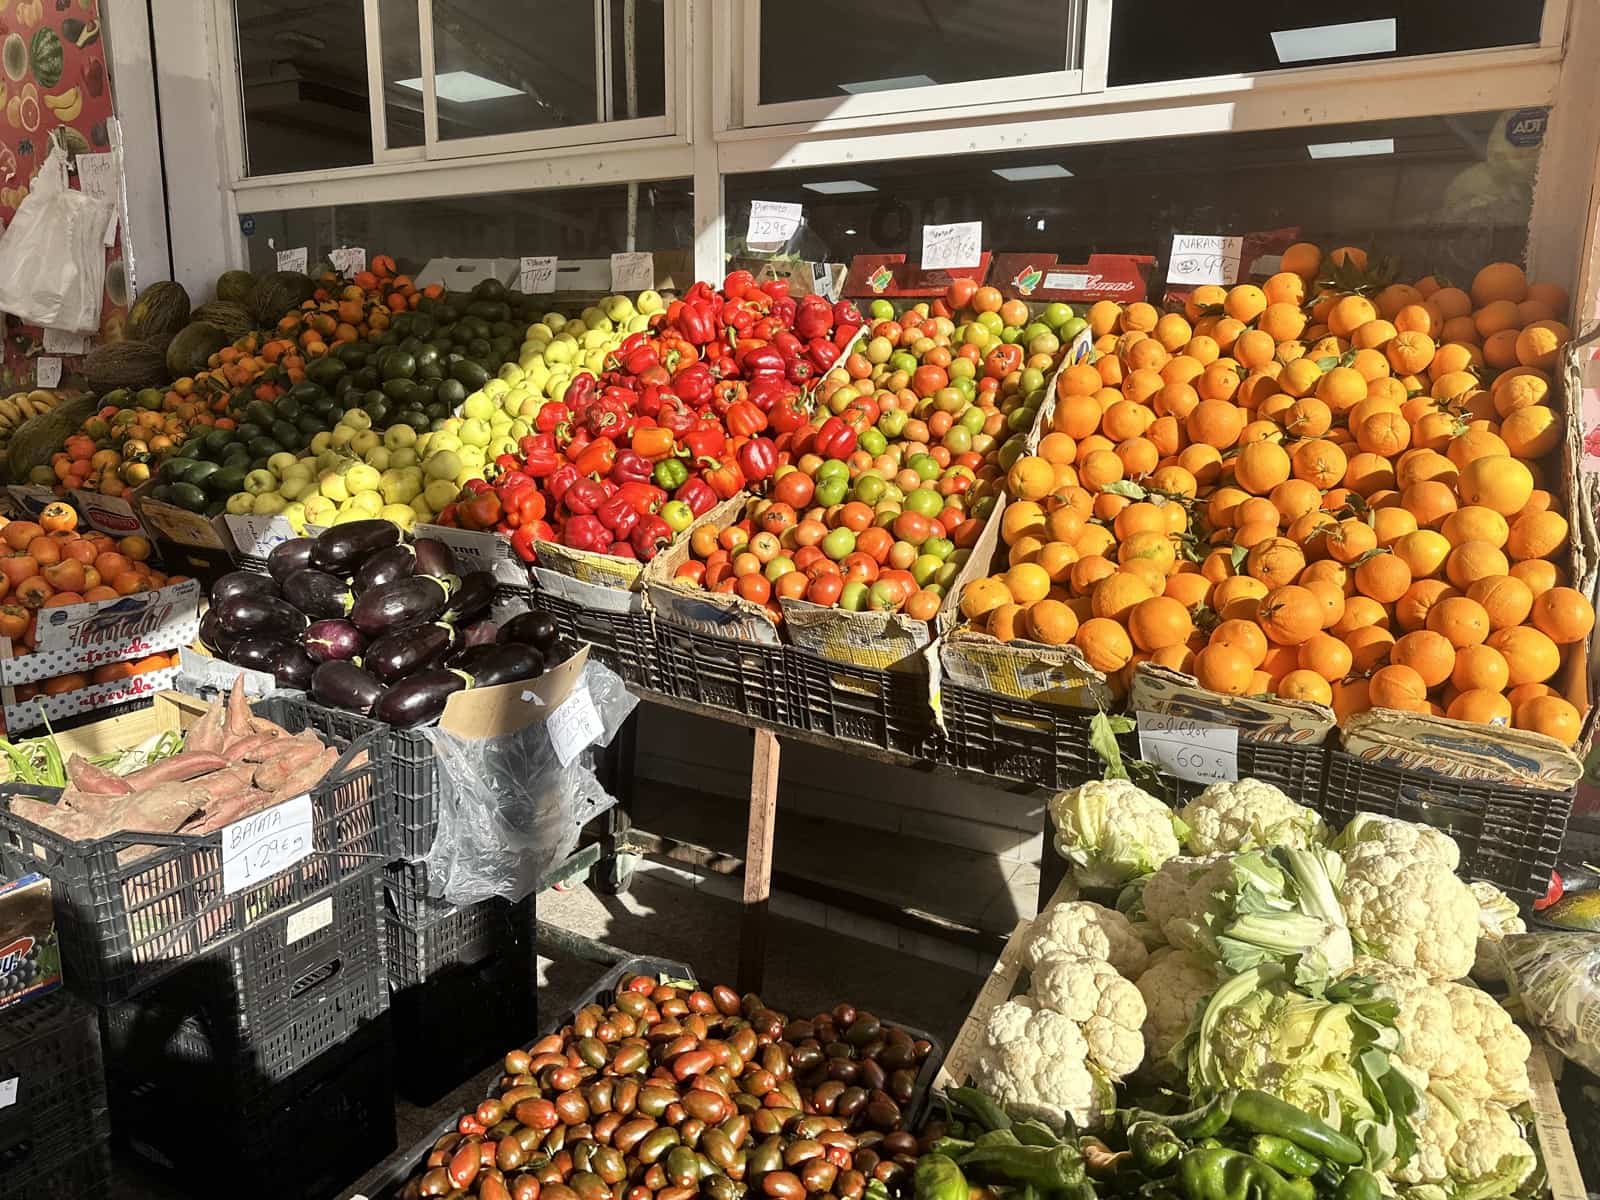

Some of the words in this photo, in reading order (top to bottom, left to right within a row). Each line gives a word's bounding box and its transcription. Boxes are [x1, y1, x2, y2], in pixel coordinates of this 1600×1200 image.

[1511, 118, 1545, 134] ADT
[1178, 238, 1234, 250] NARANJA
[77, 637, 153, 664] atrevida
[79, 677, 155, 706] atrevida
